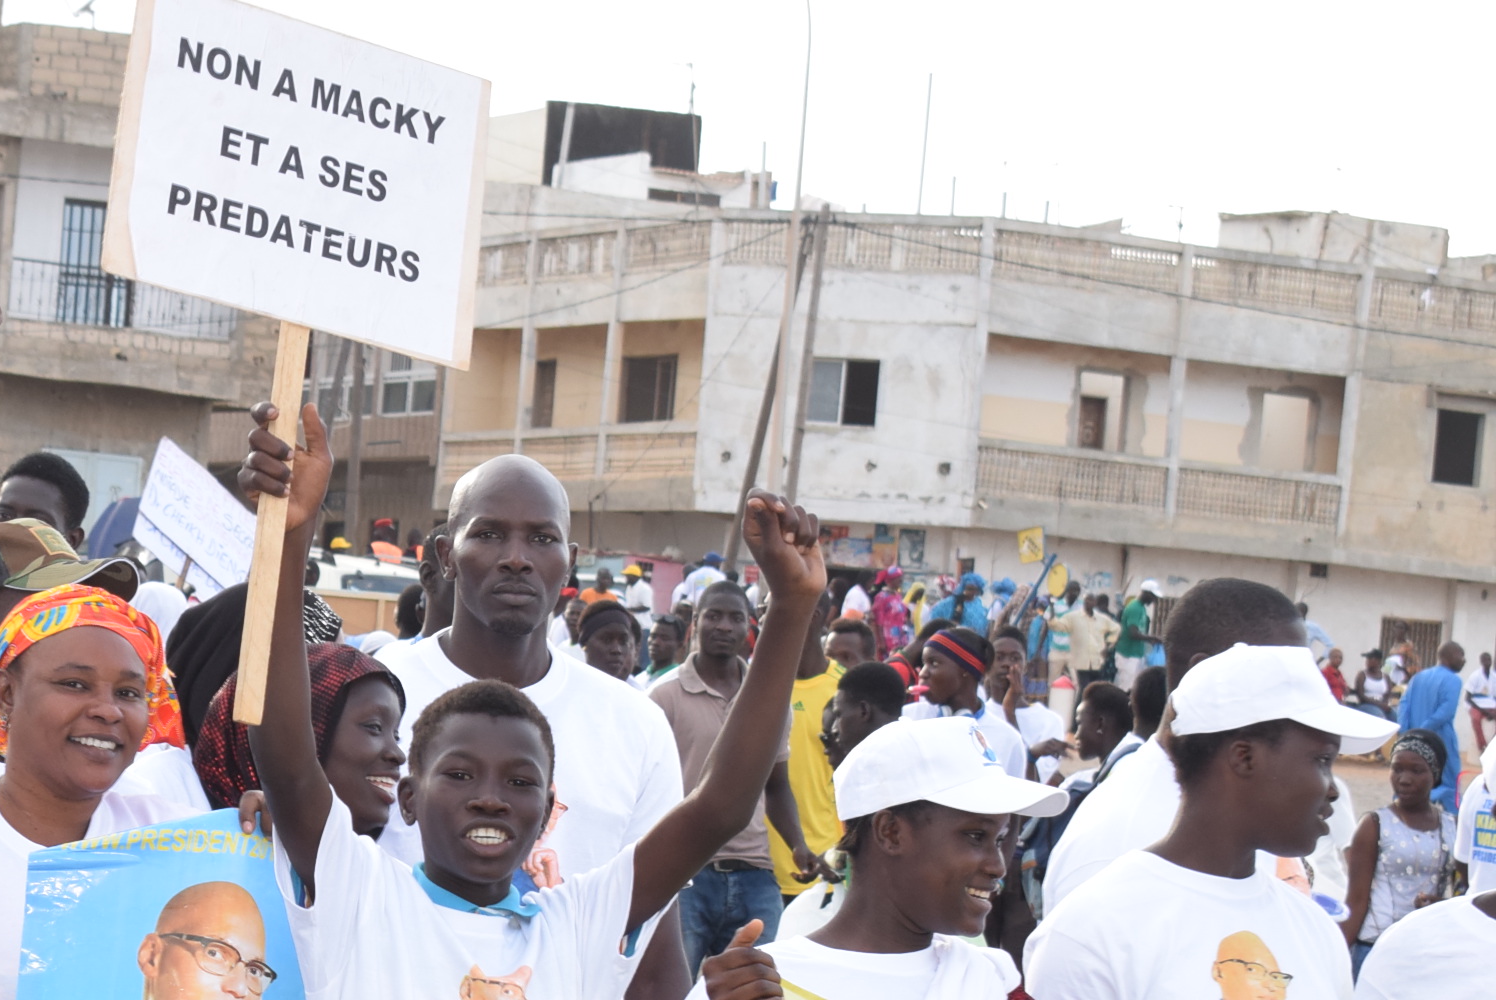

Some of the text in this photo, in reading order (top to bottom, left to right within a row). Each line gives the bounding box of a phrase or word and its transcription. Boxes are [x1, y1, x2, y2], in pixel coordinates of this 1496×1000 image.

[177, 37, 446, 145] NON A MACKY
[220, 125, 388, 202] ET A SES
[167, 183, 420, 283] PREDATEURS
